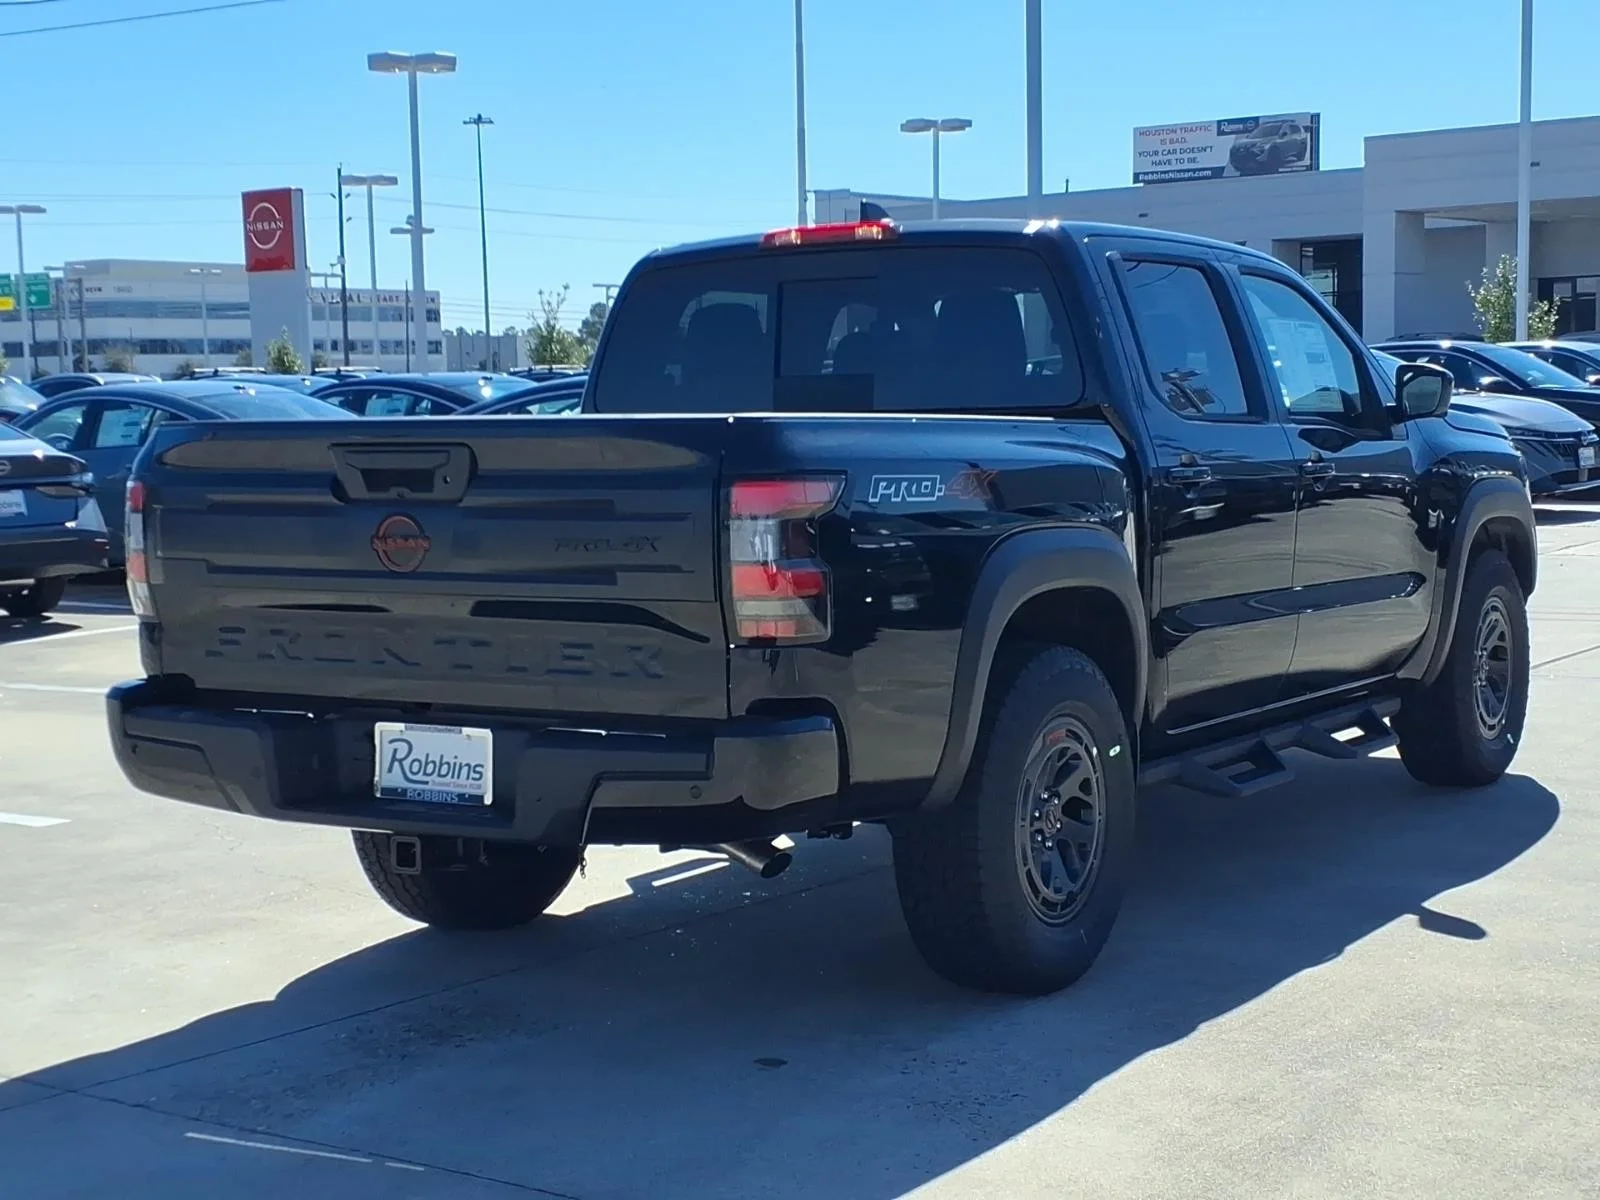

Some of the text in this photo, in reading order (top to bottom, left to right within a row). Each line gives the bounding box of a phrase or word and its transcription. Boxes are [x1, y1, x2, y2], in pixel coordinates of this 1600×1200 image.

[1139, 127, 1177, 137] HOUSTON
[1179, 125, 1213, 134] TRAFFIC
[1160, 138, 1168, 146] IS
[1138, 146, 1213, 158] YOUR CAR DOESN'T
[1151, 158, 1173, 167] HAVE
[1175, 157, 1185, 165] TO
[1139, 170, 1212, 181] RobbinsNissan.com
[247, 220, 284, 231] NISSAN
[372, 537, 430, 550] NISSAN
[204, 624, 666, 680] FRONTIER
[387, 737, 484, 785] Robbins
[407, 789, 459, 803] ROBBINS
